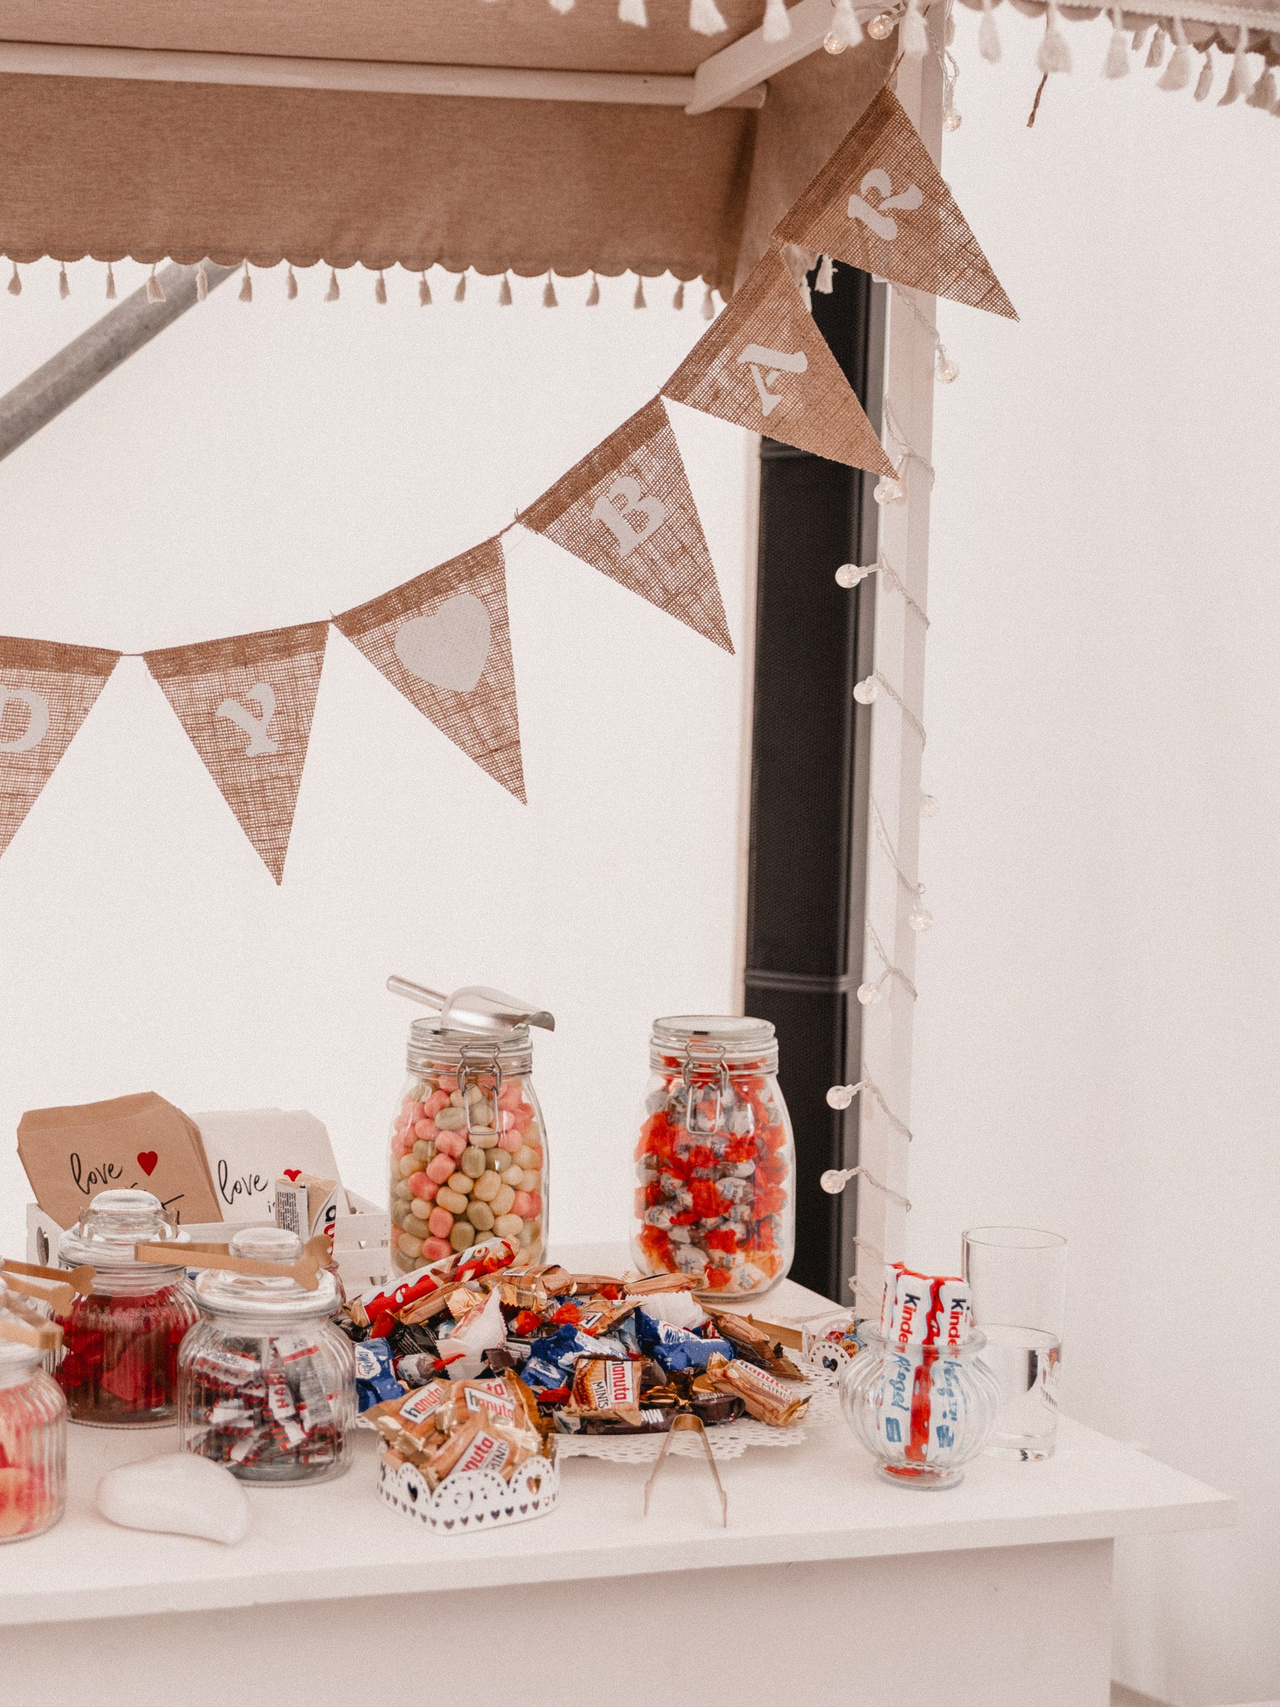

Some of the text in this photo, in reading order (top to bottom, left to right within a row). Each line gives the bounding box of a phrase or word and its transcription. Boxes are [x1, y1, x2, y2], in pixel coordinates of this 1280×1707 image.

[590, 167, 924, 557] BAR
[69, 1152, 124, 1195] love
[217, 1158, 269, 1205] love
[592, 1380, 610, 1409] MINIS
